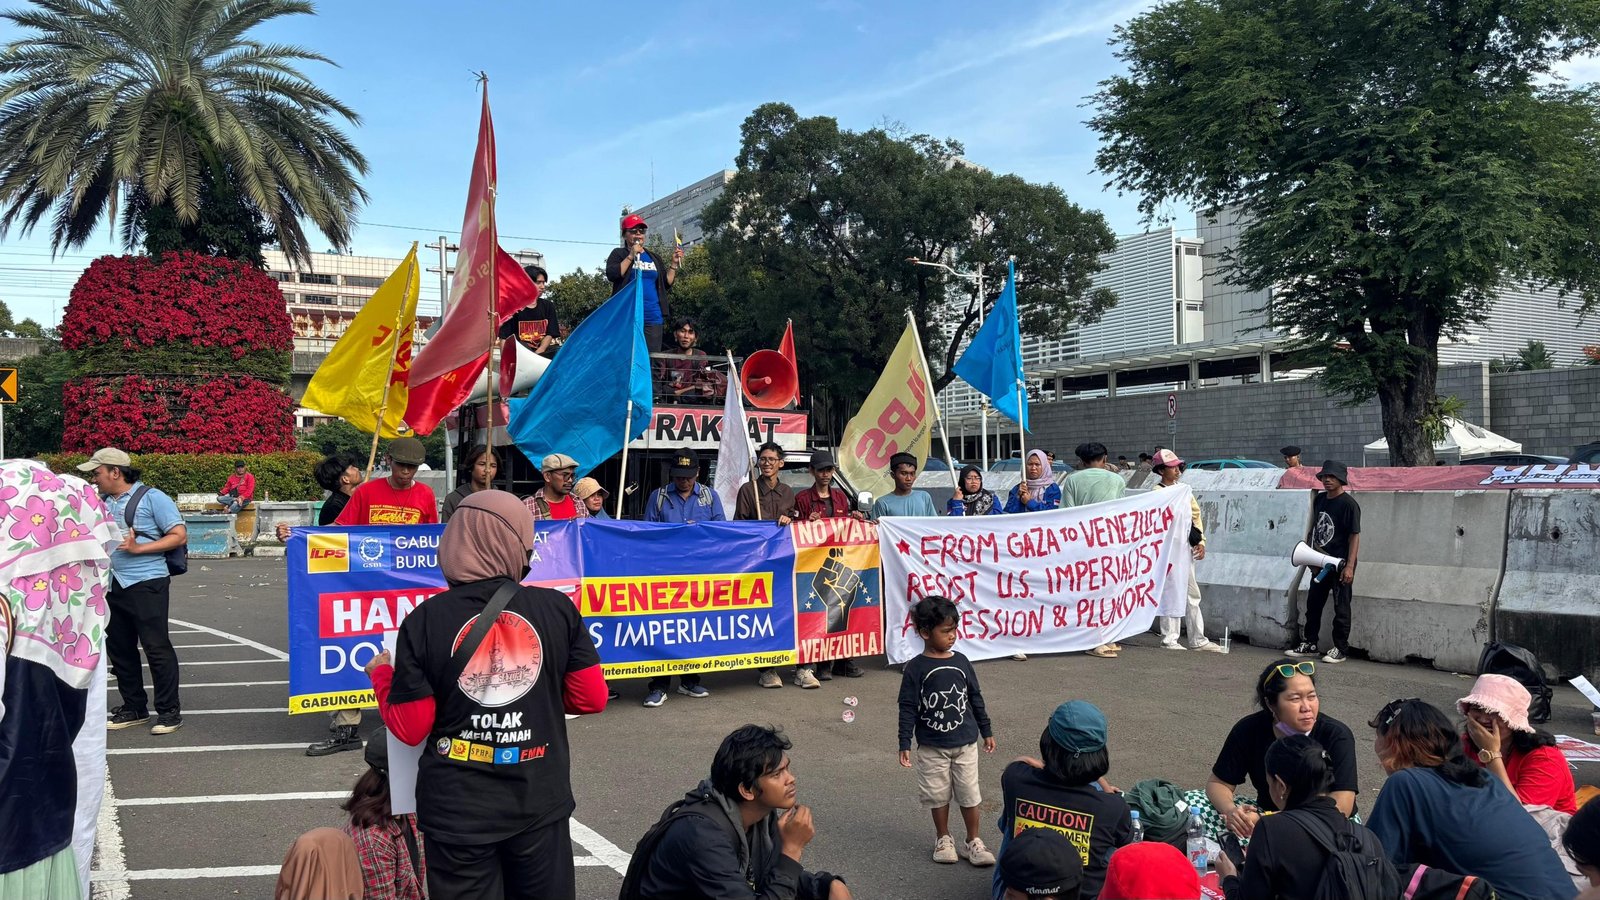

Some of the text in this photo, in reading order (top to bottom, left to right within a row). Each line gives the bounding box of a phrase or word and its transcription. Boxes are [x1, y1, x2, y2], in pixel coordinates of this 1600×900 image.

[656, 414, 781, 445] RAKAT
[395, 535, 440, 549] GABU
[798, 518, 878, 545] NO WAR
[829, 548, 843, 558] ON
[920, 532, 999, 567] FROM
[1007, 527, 1060, 558] GAZA
[396, 555, 438, 569] BURU
[906, 540, 1163, 605] RESIST U.S. IMPERIALIST
[586, 578, 769, 612] VENEZUELA
[333, 594, 436, 633] HAN
[902, 605, 1044, 640] AESSION
[1053, 605, 1068, 627] &
[614, 613, 775, 647] IMPERIALISM
[320, 642, 385, 674] DO
[802, 632, 878, 663] VENEZUELA
[602, 654, 790, 676] International League of People's Struggle
[301, 693, 377, 708] GABUNGAN
[471, 711, 523, 729] TOLAK
[459, 729, 531, 743] MAFIA TANAH
[520, 745, 546, 760] FMN
[1019, 803, 1088, 830] CAUTION
[1057, 830, 1089, 843] OMEN
